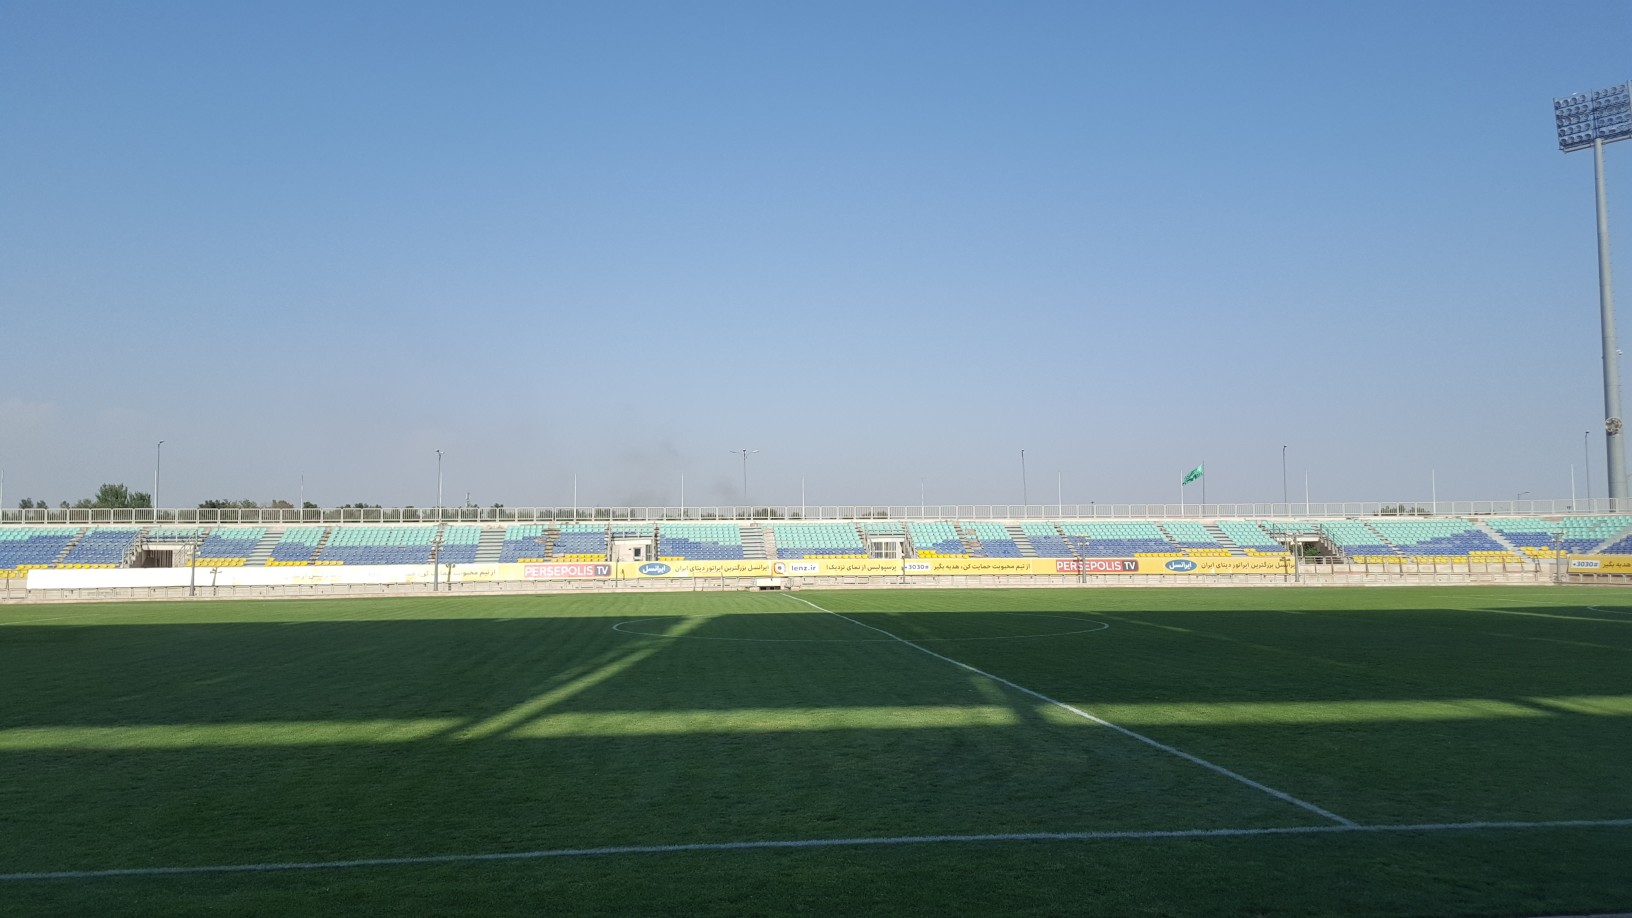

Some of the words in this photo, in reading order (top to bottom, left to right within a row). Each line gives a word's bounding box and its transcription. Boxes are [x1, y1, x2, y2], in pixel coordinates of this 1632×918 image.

[642, 565, 666, 574] ایرانسل
[1056, 561, 1122, 571] PERSEPOLIS
[1124, 561, 1136, 570] TV
[1168, 561, 1192, 570] ایرانسل
[525, 566, 593, 576] PERSEPOLIS
[597, 566, 609, 575] TV
